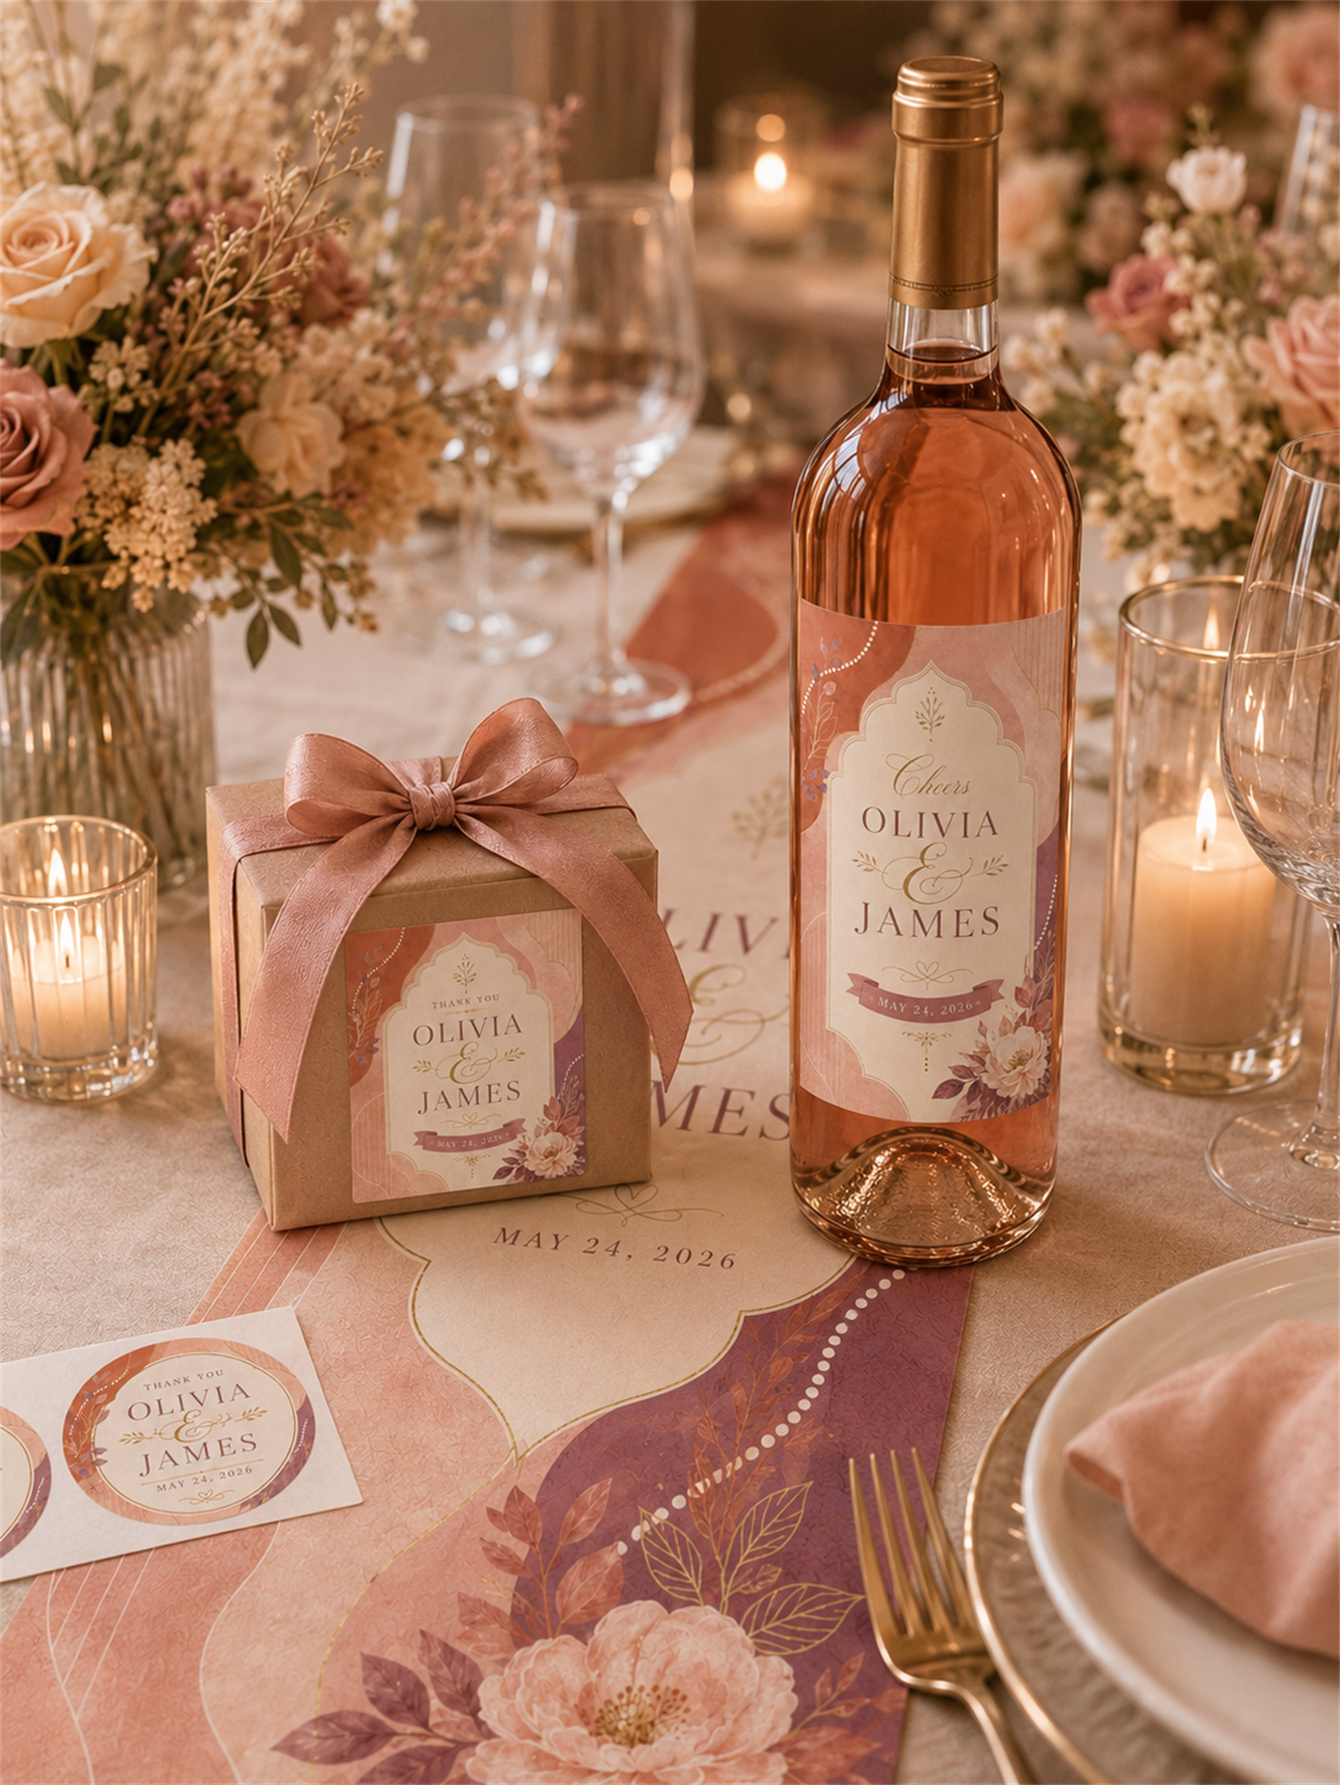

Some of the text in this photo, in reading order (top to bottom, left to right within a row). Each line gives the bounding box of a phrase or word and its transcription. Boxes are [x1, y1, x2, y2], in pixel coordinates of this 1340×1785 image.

[885, 753, 971, 799] Cheers
[862, 806, 998, 838] OLIVIA
[882, 842, 973, 905] &
[854, 902, 999, 938] JAMES
[431, 994, 500, 1010] THANK YOU
[877, 997, 907, 1012] MAY
[913, 1004, 934, 1016] 24,
[412, 1014, 522, 1046] OLIVIA
[434, 1041, 498, 1084] &
[417, 1080, 521, 1115] JAMES
[651, 1080, 790, 1141] MES
[493, 1227, 736, 1270] MAY 24, 2026
[143, 1369, 224, 1392] THANK YOU
[127, 1383, 251, 1422] OLIVIA
[159, 1409, 232, 1443] &
[139, 1433, 258, 1477] JAMES
[156, 1465, 253, 1492] MAY 24, 2026
